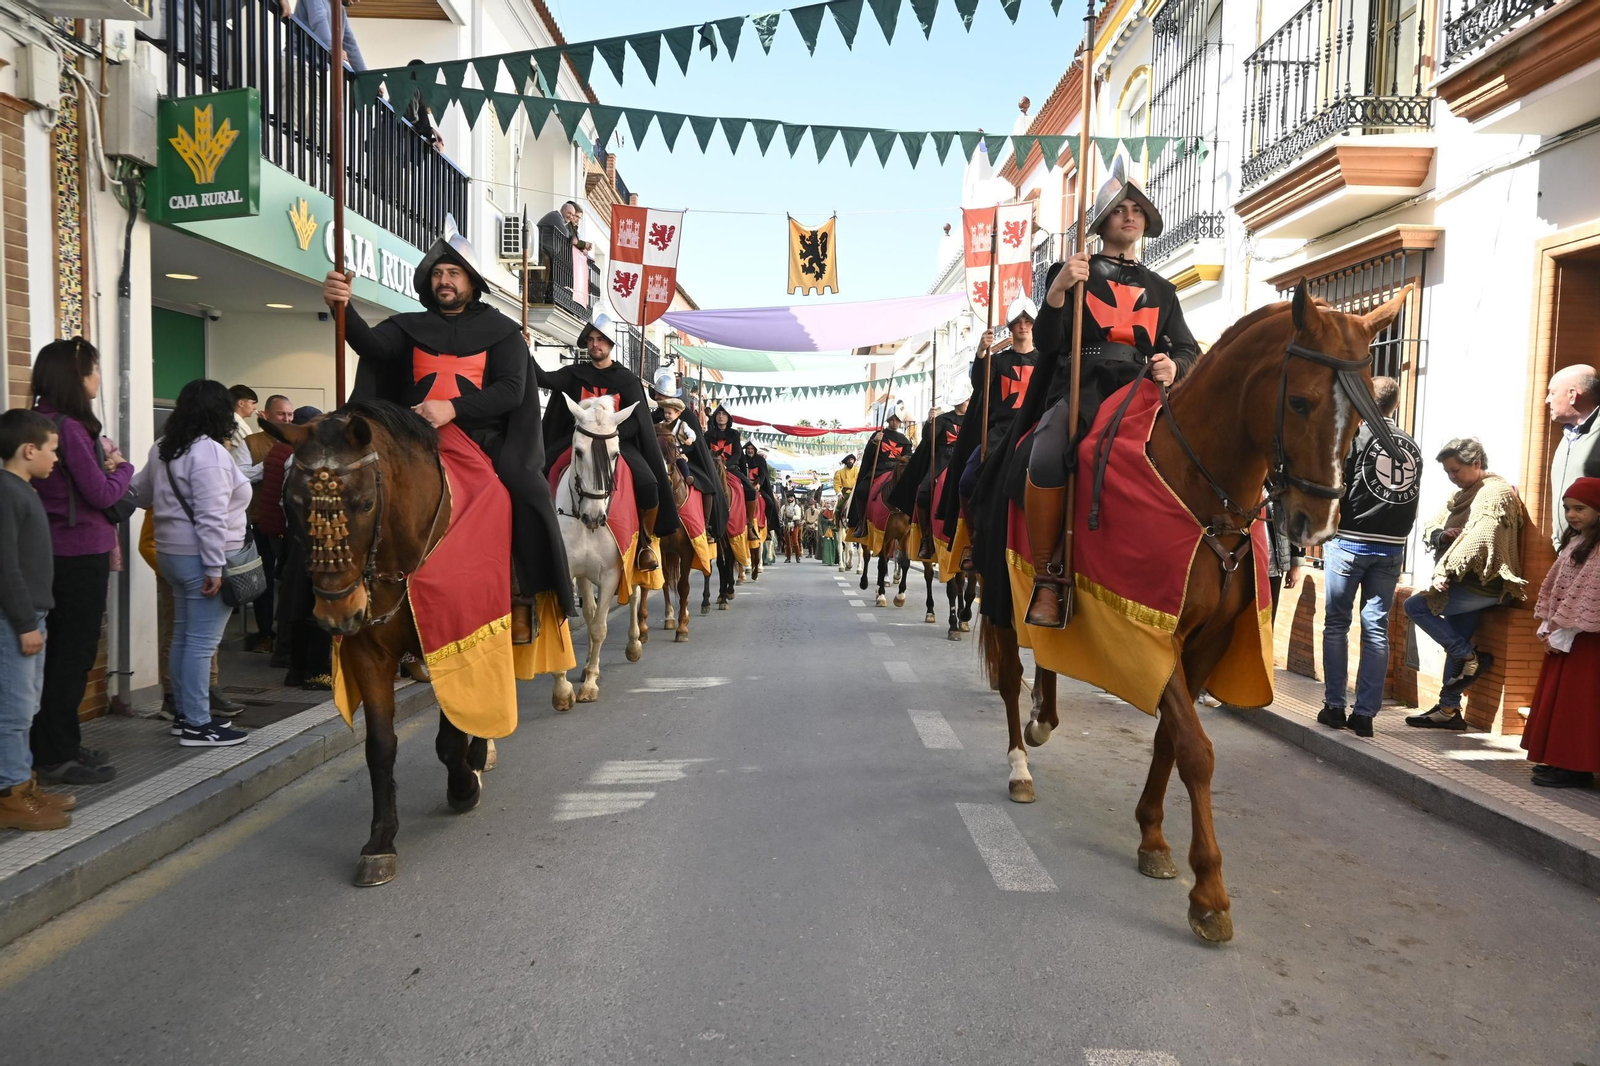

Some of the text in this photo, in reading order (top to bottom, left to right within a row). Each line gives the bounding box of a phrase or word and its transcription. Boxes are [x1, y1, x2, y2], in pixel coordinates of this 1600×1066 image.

[169, 189, 243, 209] CAJA RURAL
[379, 247, 420, 301] RUR
[1369, 437, 1421, 463] BRKLYN
[1370, 479, 1419, 501] NEW YORK
